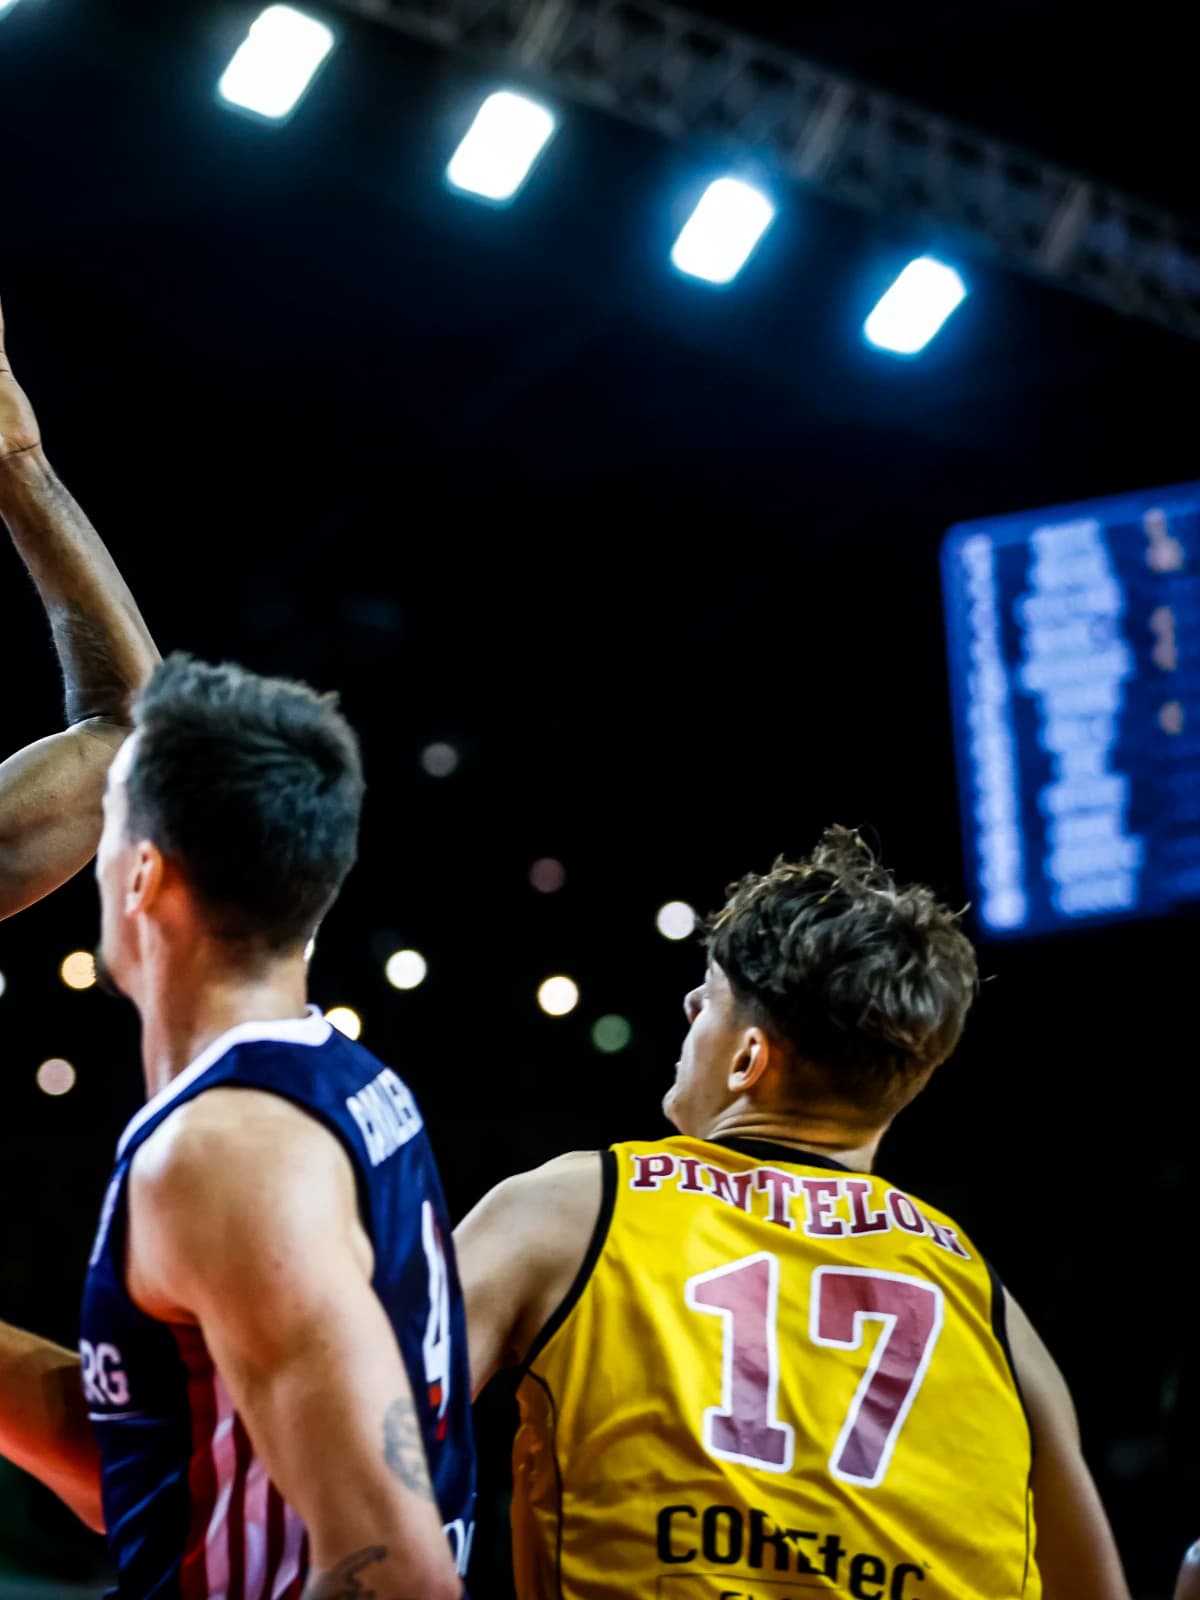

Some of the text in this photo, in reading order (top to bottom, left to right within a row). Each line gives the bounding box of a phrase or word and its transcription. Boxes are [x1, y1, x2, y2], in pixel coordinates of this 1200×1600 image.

[422, 1200, 452, 1428] 4
[630, 1154, 971, 1260] PINTELON
[686, 1251, 943, 1487] 17
